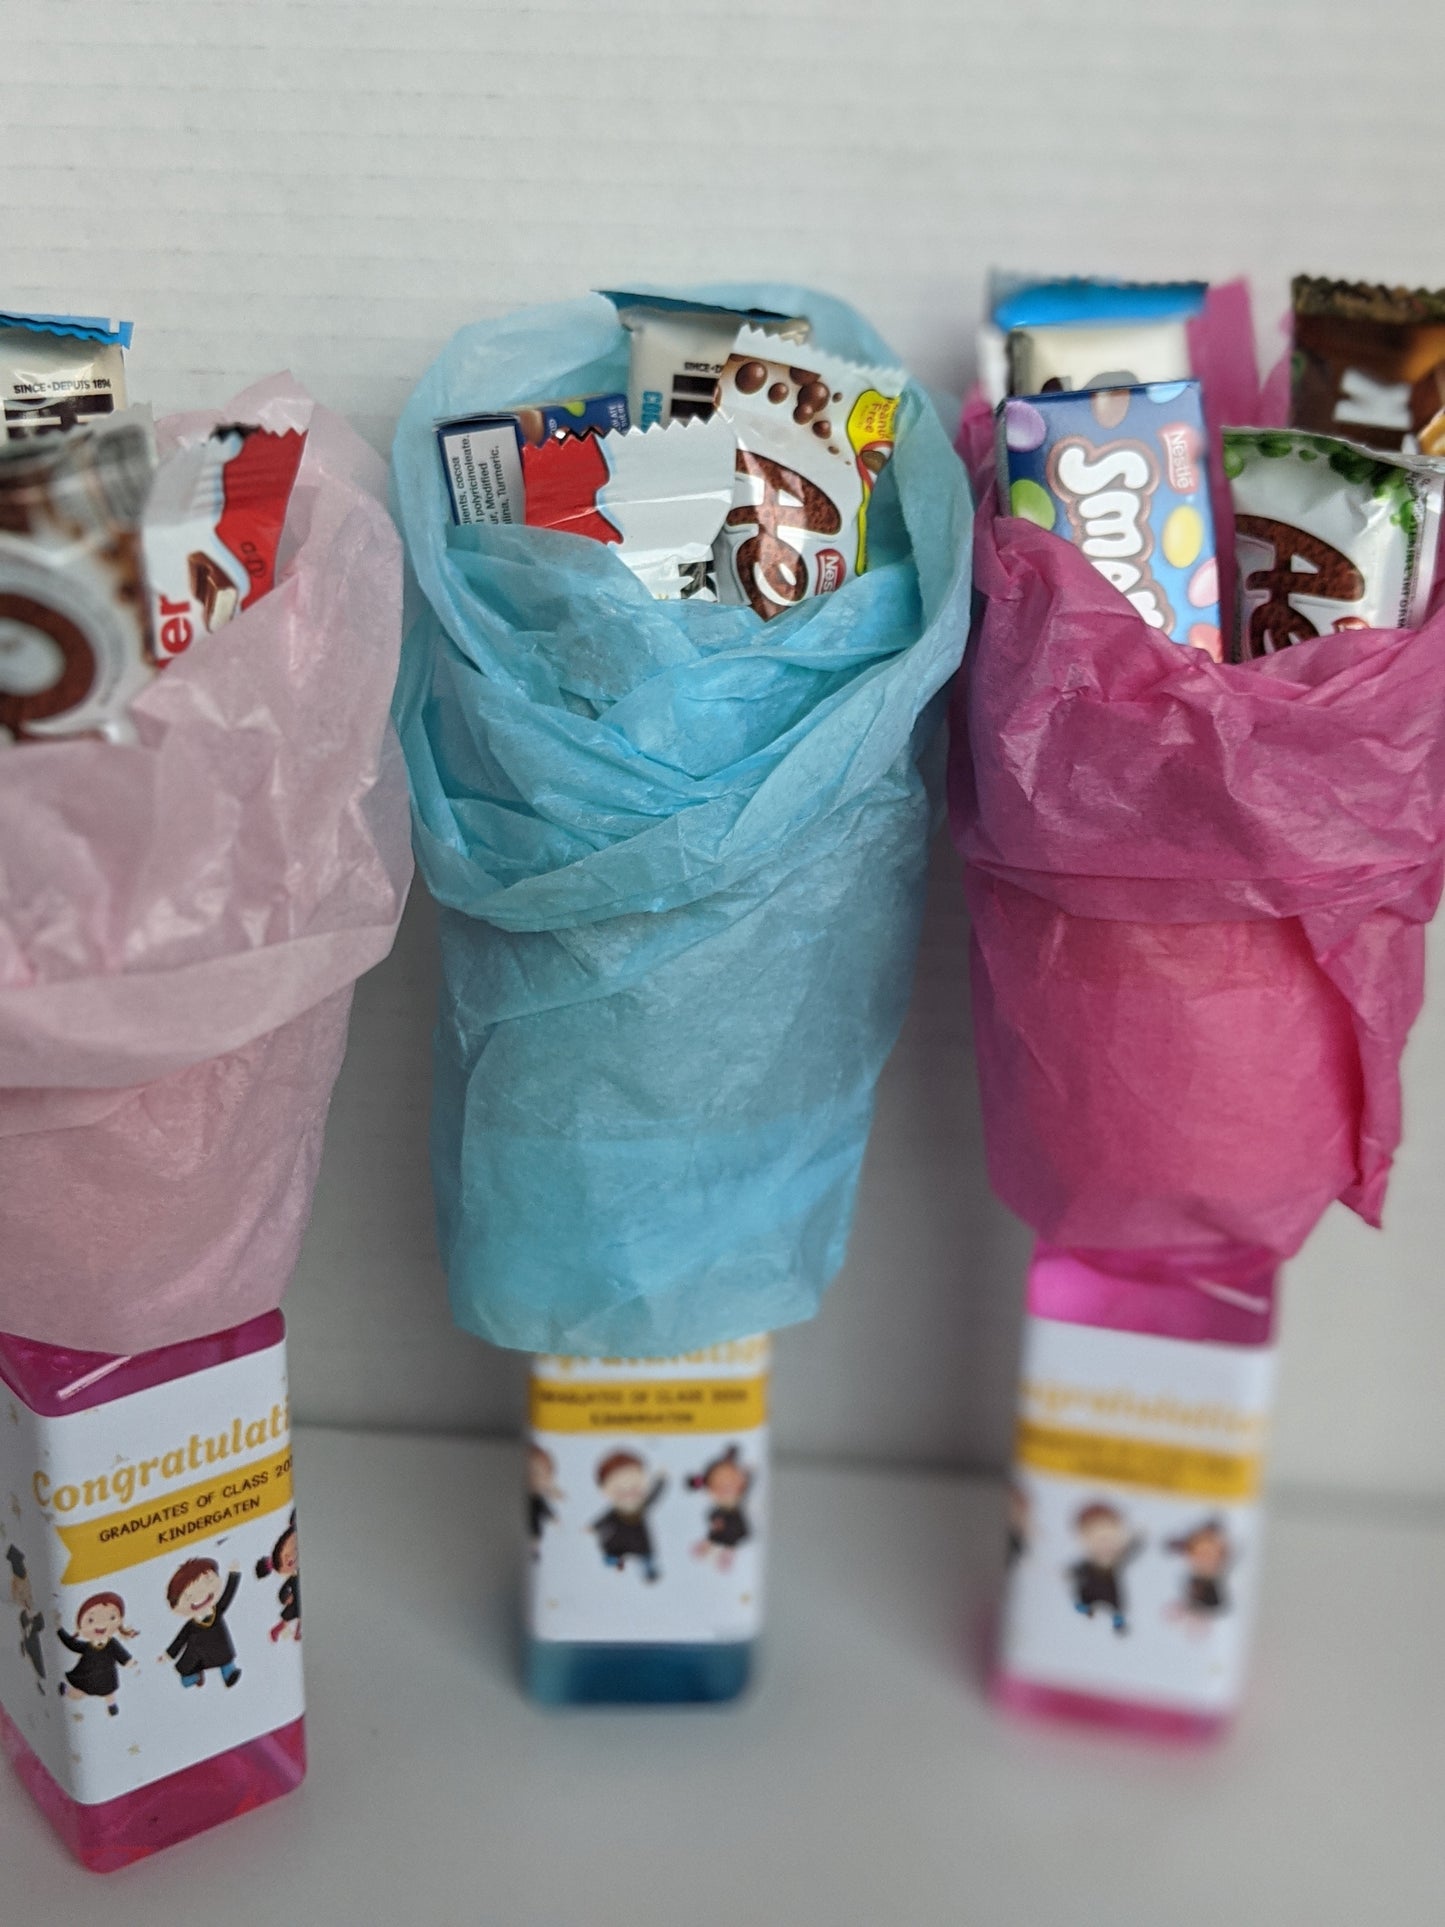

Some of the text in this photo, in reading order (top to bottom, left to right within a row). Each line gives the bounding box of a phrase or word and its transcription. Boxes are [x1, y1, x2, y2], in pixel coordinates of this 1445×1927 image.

[452, 456, 465, 490] cocoa
[478, 462, 496, 510] Modified
[99, 1455, 292, 1543] GRADUATES OF CLASS 20
[157, 1495, 261, 1544] KINDERGATEN
